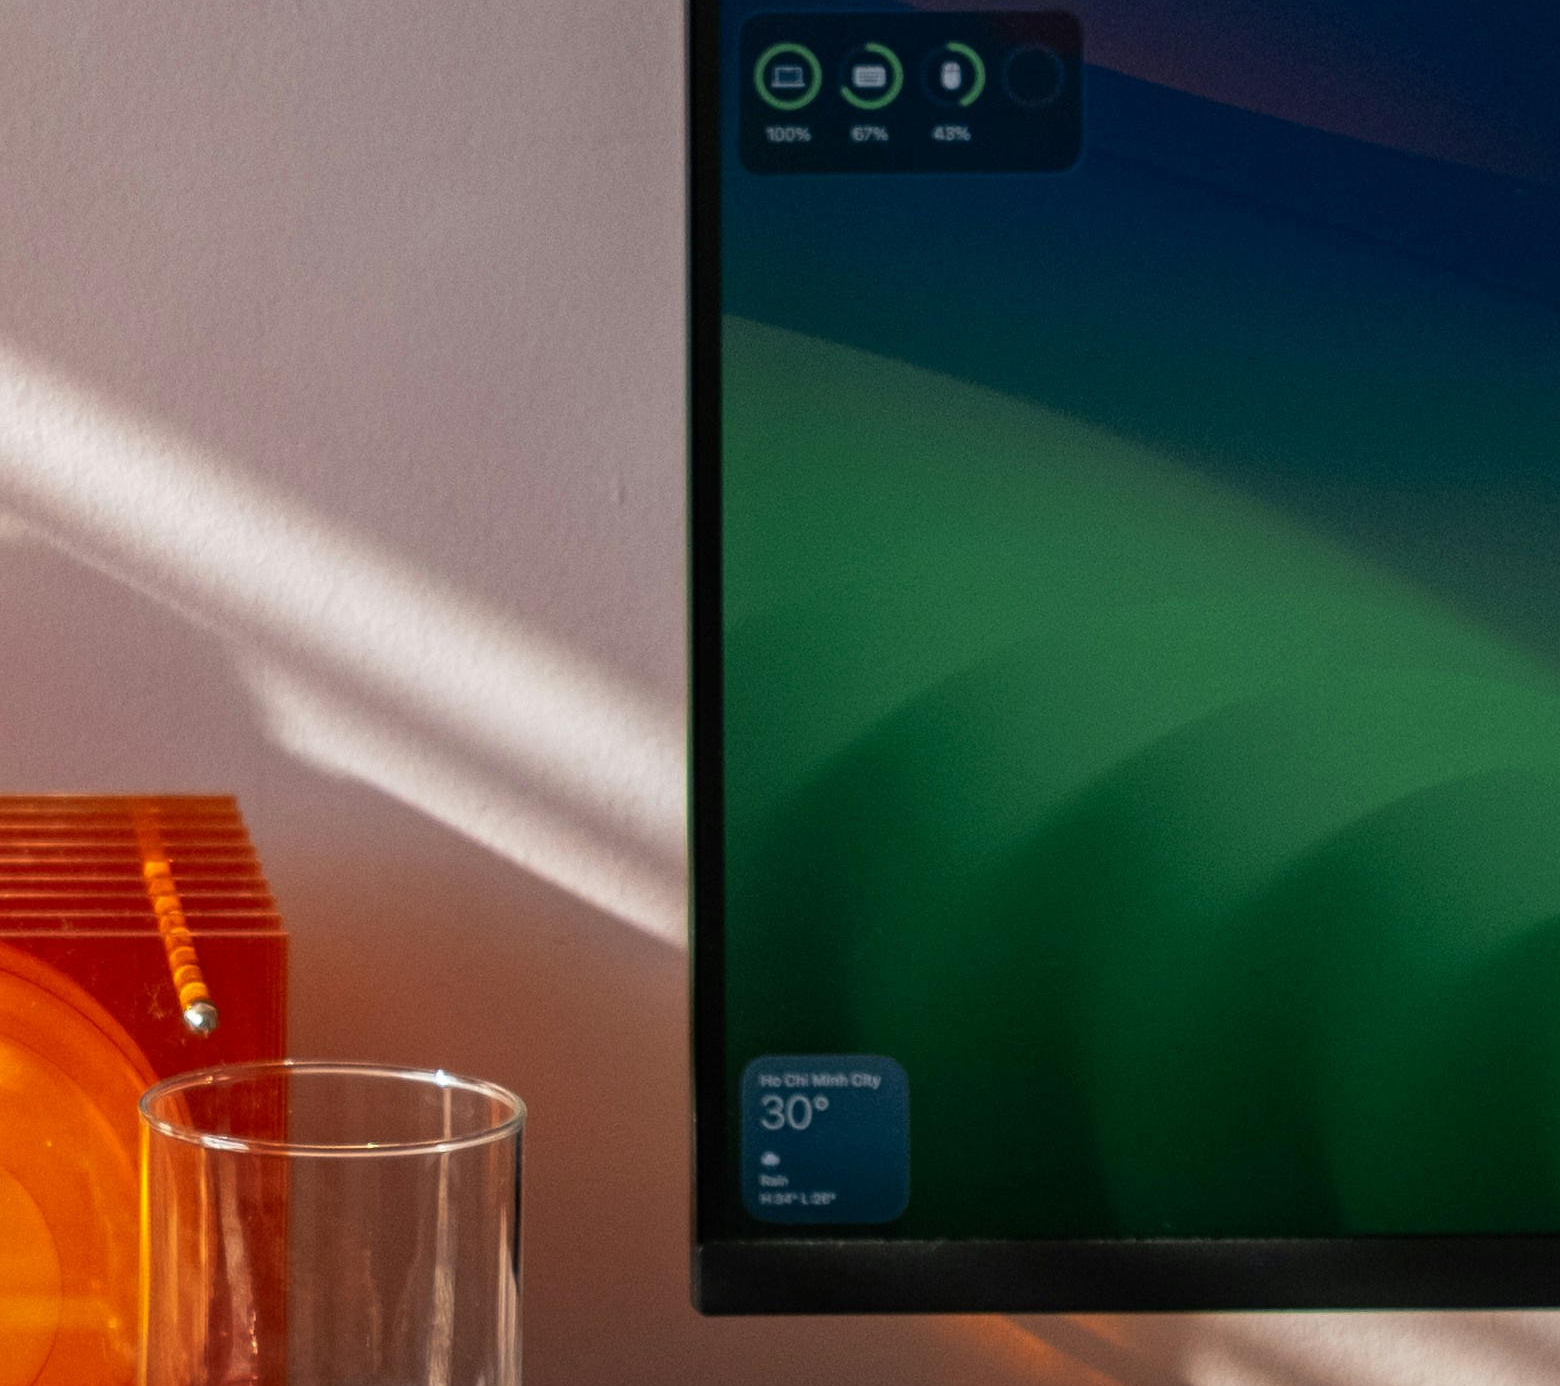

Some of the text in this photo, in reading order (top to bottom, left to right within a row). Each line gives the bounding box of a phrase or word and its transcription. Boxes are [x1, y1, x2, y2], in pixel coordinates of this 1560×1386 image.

[766, 126, 812, 143] 100%
[759, 1072, 882, 1090] Ho Chi Minh City
[760, 1093, 829, 1131] 30°
